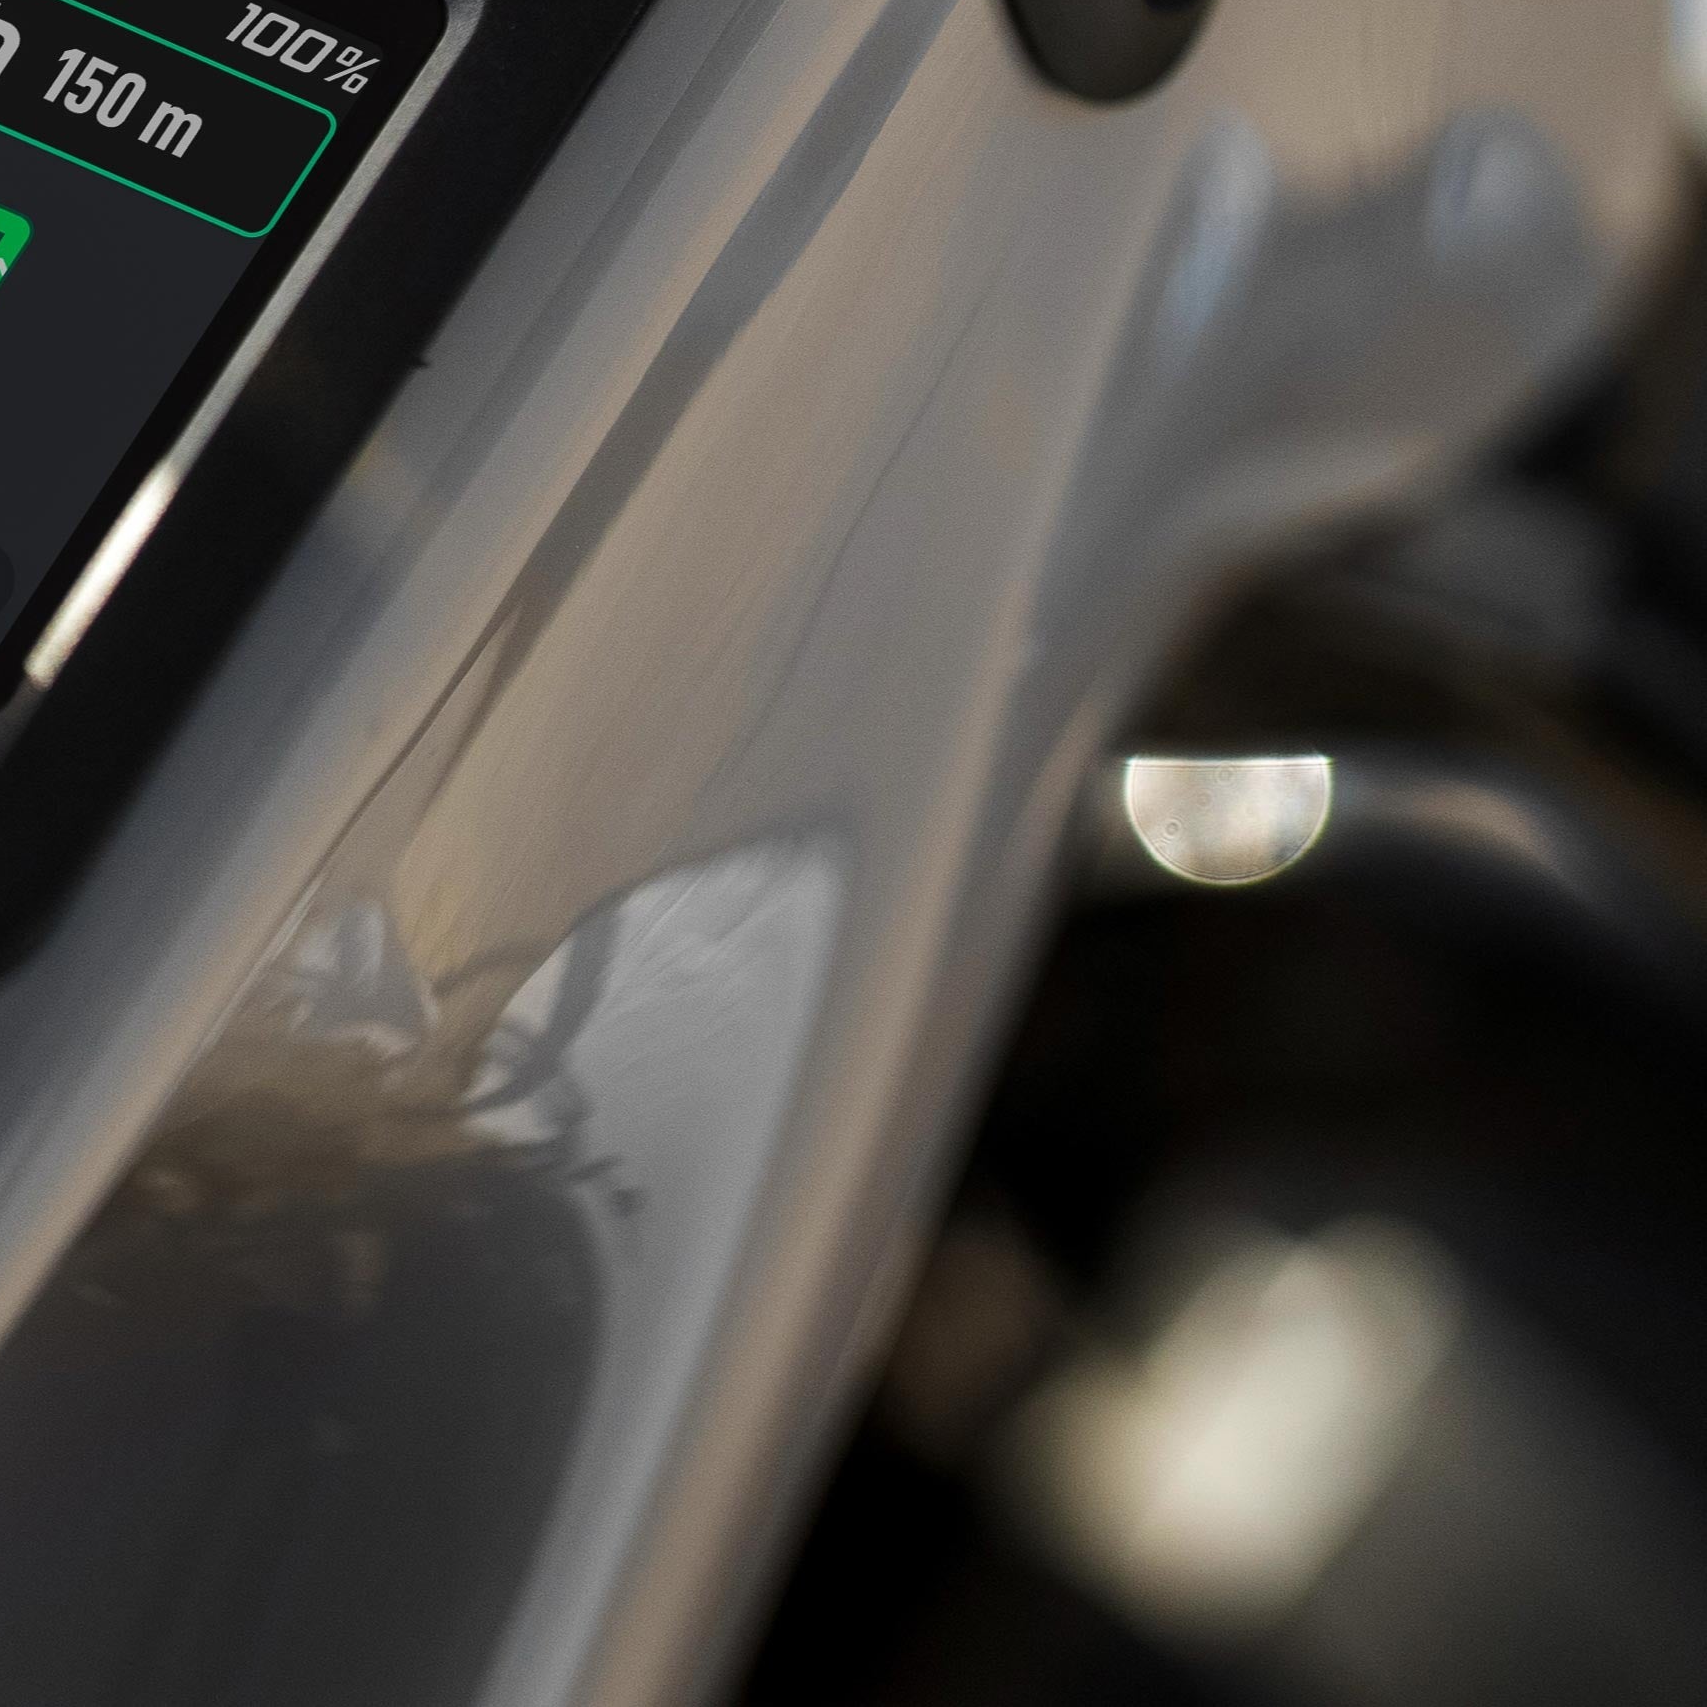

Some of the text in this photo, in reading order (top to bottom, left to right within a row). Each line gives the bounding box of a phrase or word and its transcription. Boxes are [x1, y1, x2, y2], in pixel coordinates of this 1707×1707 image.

[225, 2, 380, 94] 100%
[44, 49, 203, 158] 150 m
